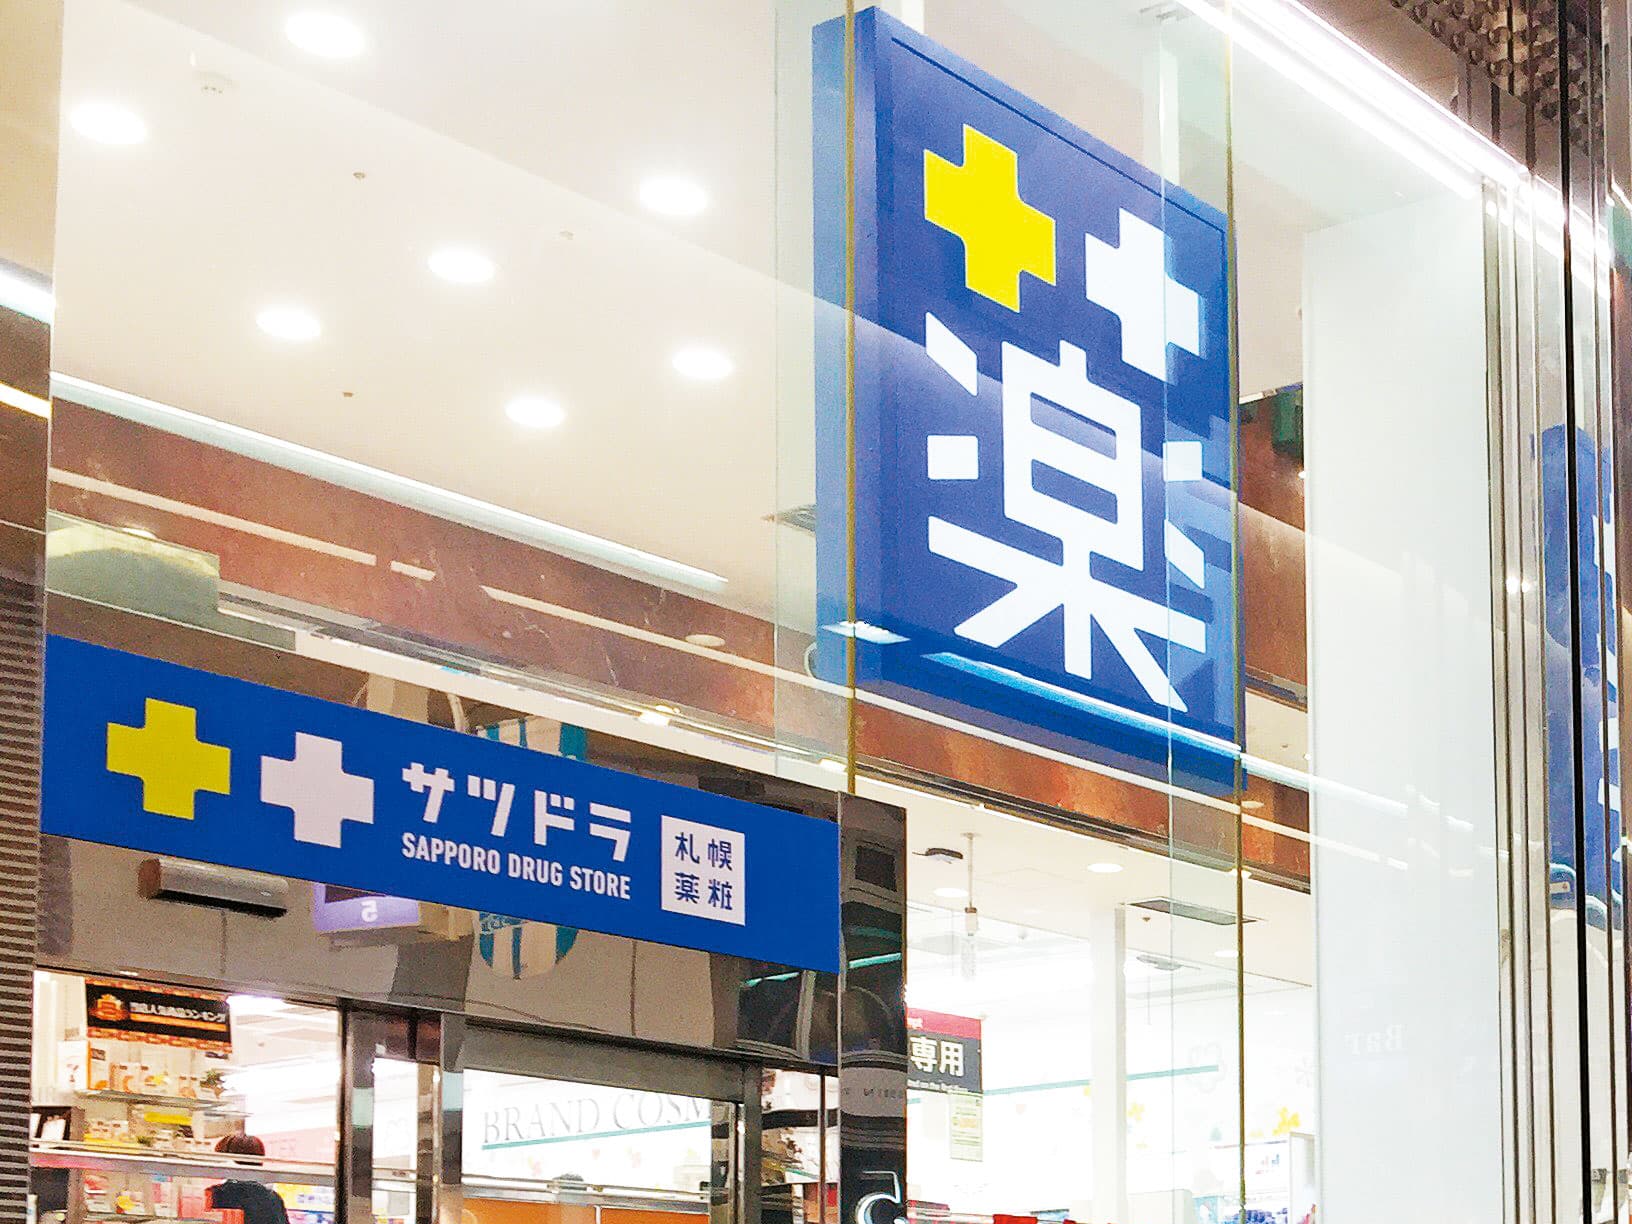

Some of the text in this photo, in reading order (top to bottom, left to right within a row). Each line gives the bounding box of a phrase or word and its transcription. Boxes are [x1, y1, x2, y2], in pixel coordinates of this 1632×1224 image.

[402, 762, 632, 862] サツドラ
[402, 832, 632, 900] SAPPORO DRUG STORE
[674, 831, 733, 871] 札幌
[483, 1098, 600, 1144] BRAND
